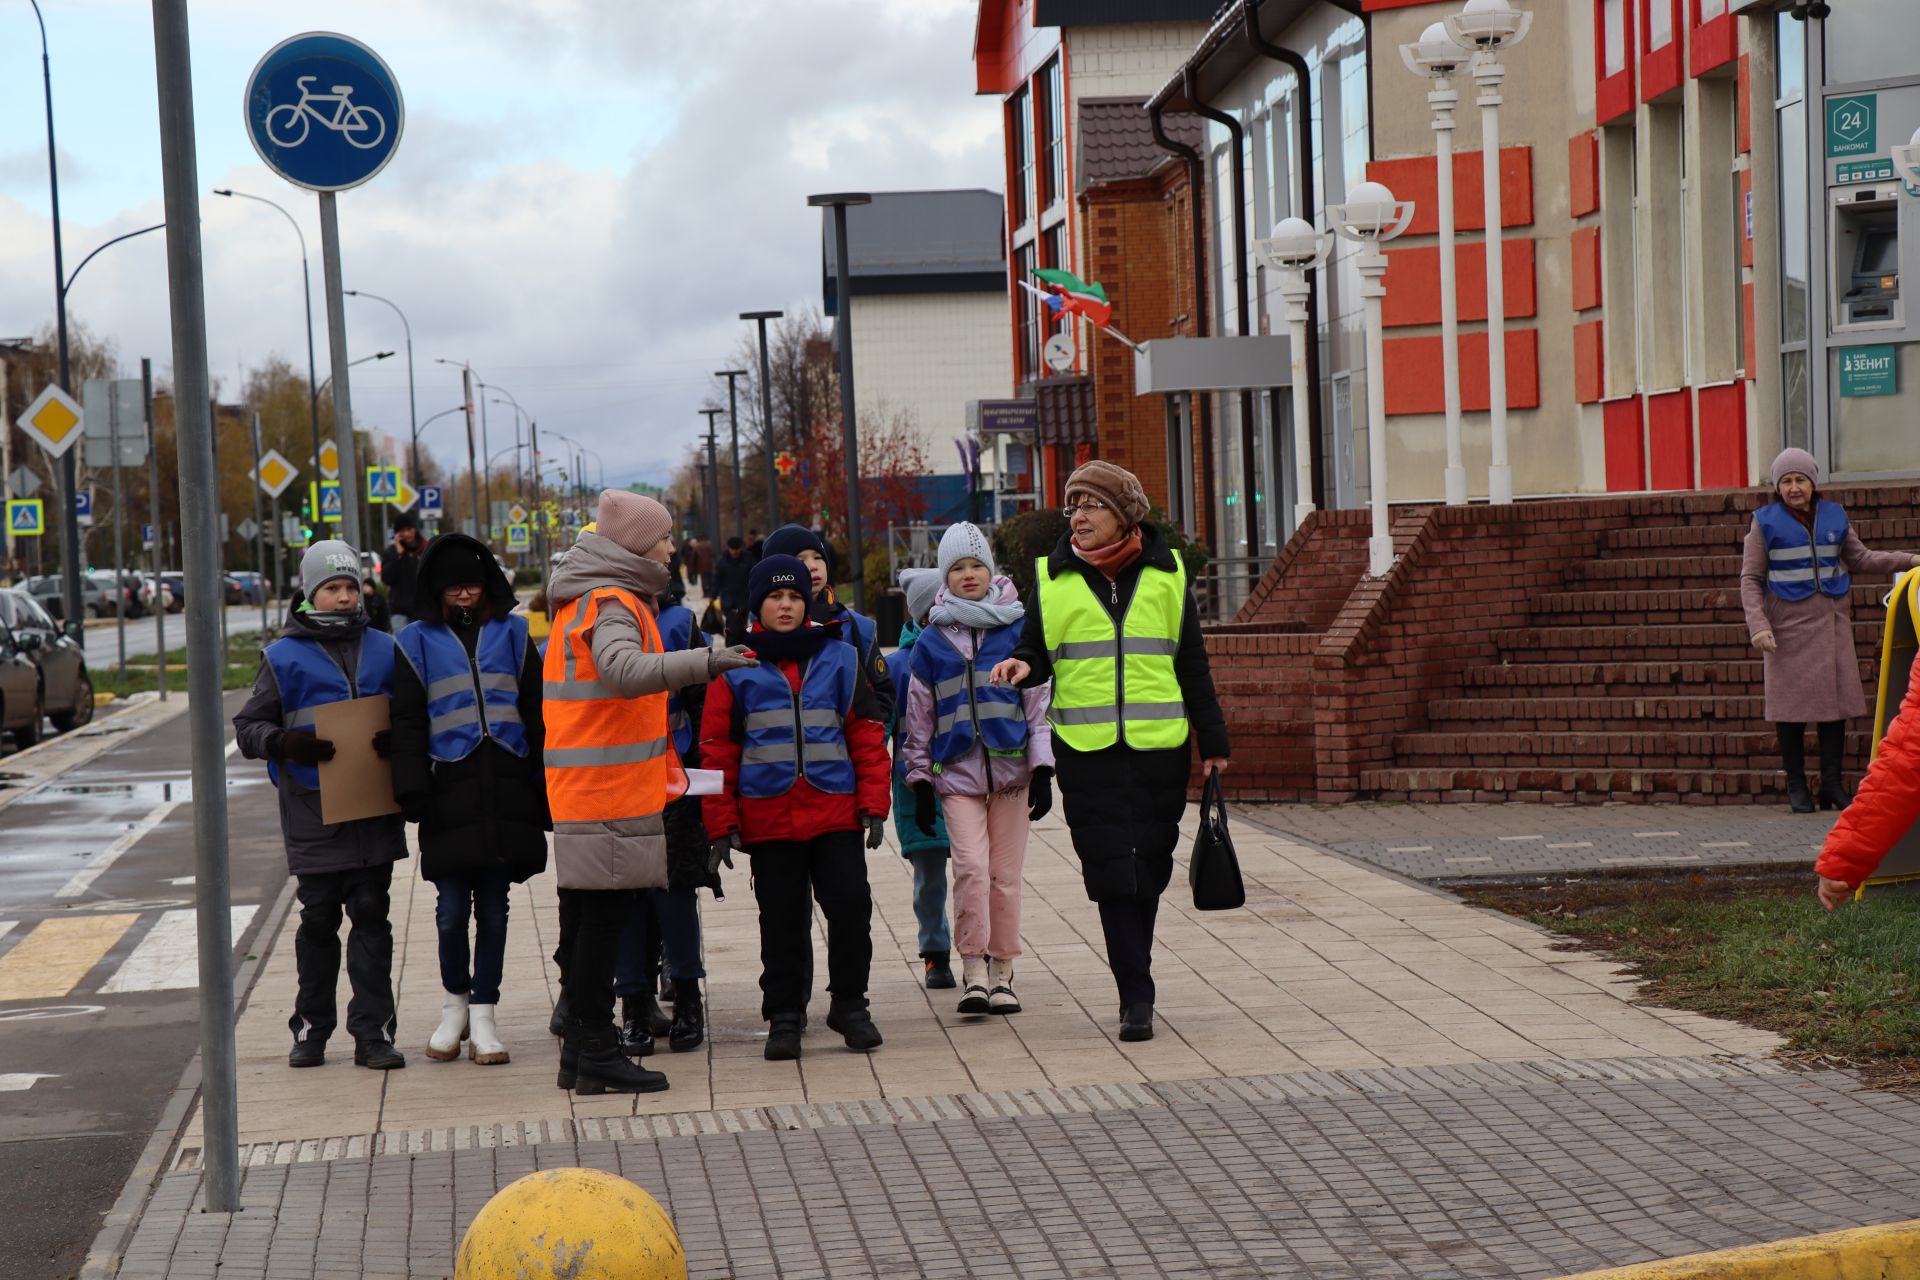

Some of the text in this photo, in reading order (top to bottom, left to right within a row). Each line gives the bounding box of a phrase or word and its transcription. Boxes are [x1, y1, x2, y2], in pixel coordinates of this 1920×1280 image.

[1841, 111, 1861, 130] 24
[1833, 142, 1868, 152] БАНКОМАТ
[1853, 357, 1890, 371] ЗЕНИТ
[425, 489, 438, 507] P
